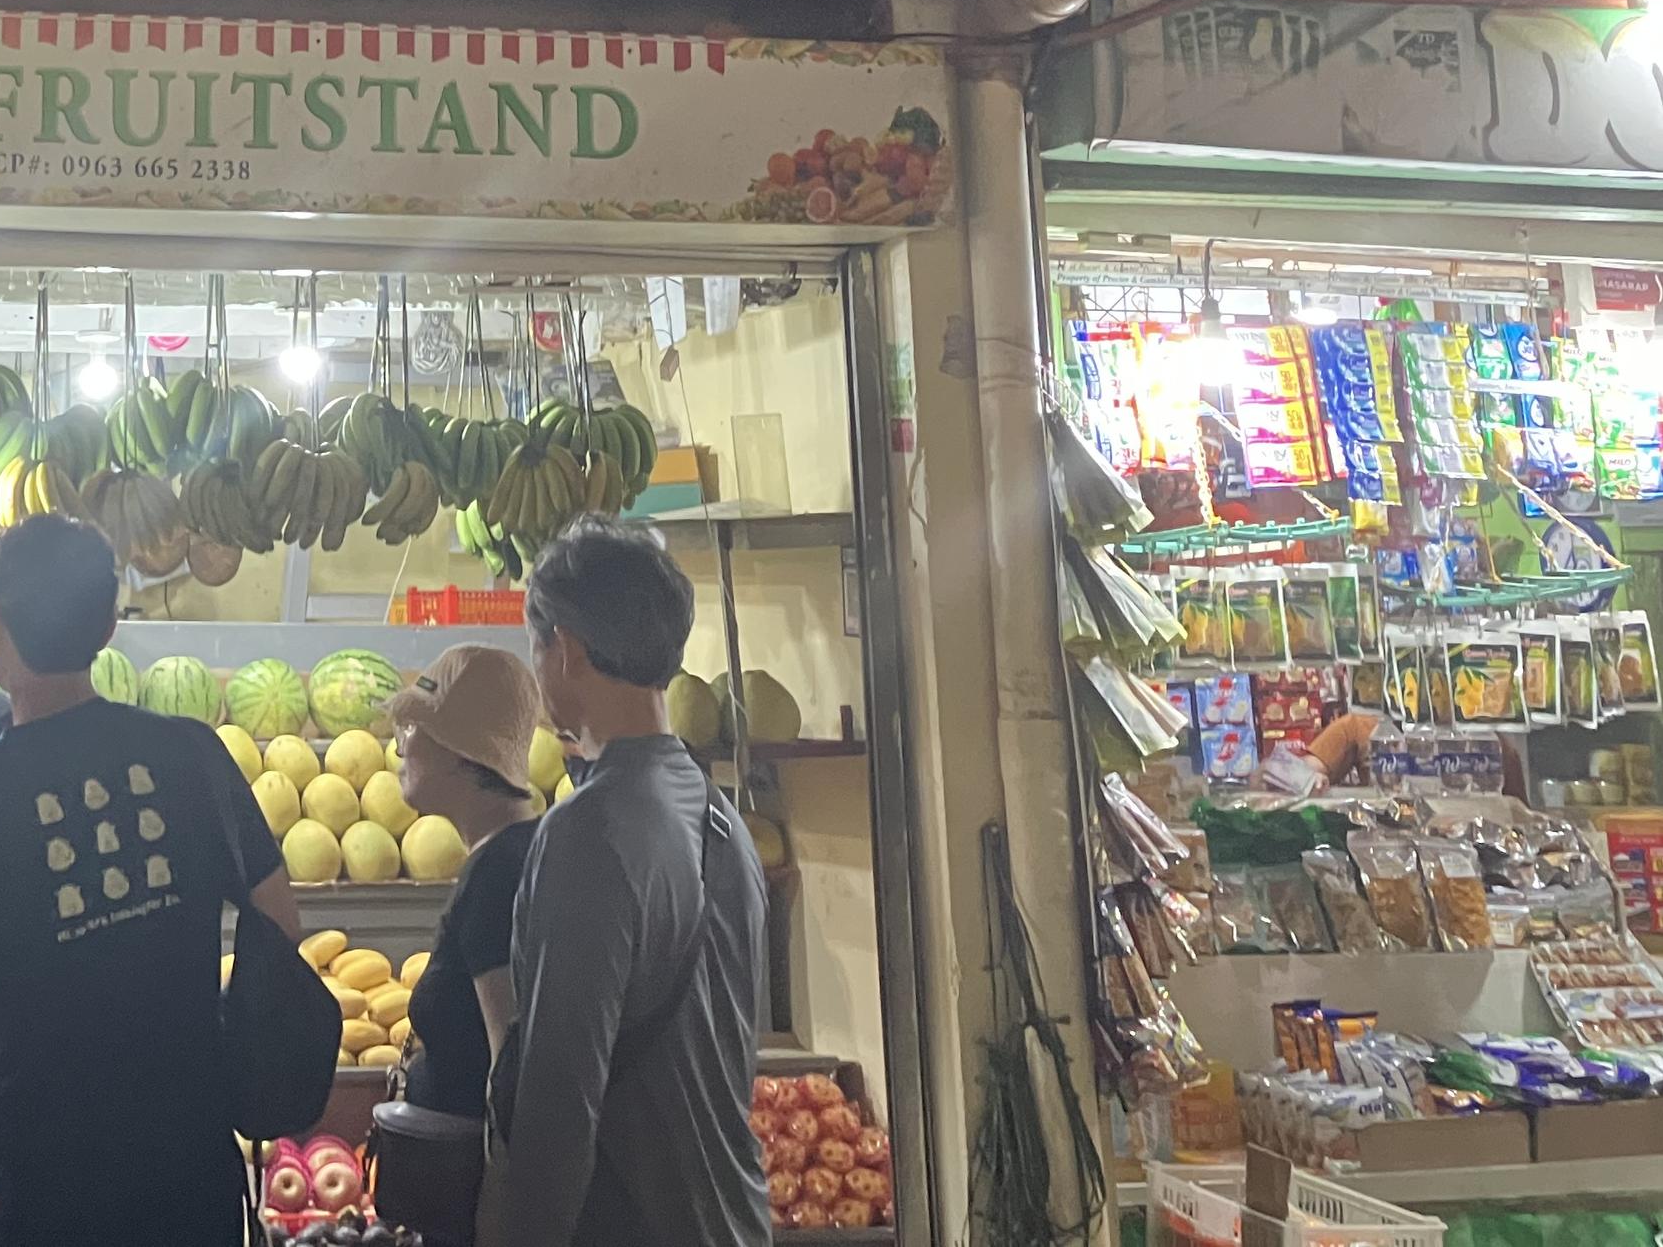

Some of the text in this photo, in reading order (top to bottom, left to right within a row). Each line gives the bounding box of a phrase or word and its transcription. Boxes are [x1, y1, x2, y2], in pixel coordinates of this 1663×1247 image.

[61, 154, 123, 178] 0963
[133, 156, 179, 180] 665
[190, 159, 251, 181] 2338
